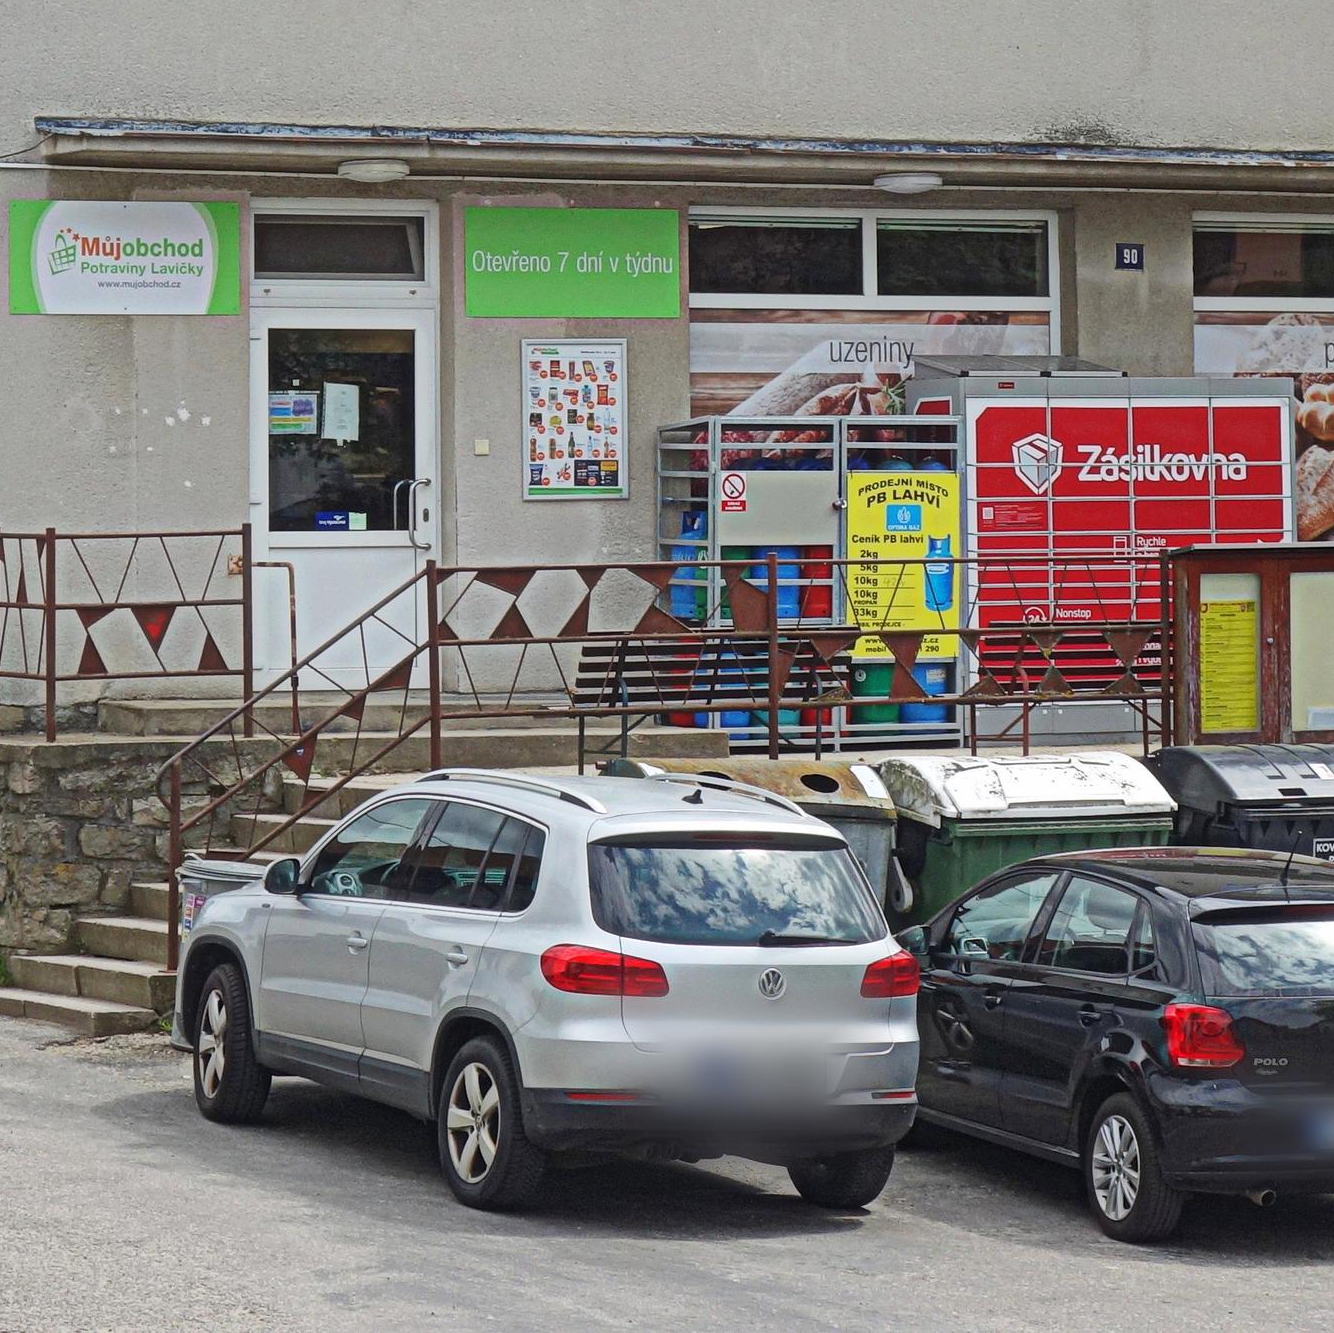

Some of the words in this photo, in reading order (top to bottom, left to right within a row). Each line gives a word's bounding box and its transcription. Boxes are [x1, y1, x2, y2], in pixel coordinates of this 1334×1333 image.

[80, 235, 204, 261] Můjobchod
[1123, 248, 1138, 265] 90
[80, 261, 146, 277] Potraviny
[150, 261, 204, 277] Lavičky
[472, 250, 551, 272] Otevřeno
[557, 251, 569, 273] 7
[576, 251, 603, 273] dní
[608, 256, 619, 273] v
[625, 251, 673, 278] týdnu
[97, 280, 182, 290] www.mujobchod.cz
[829, 335, 915, 369] uzeniny
[1076, 444, 1247, 482] Zásilkovna
[858, 477, 913, 497] PRODEJNÍ
[866, 491, 887, 508] PB
[892, 489, 941, 509] LAHVÍ
[883, 534, 897, 544] PB
[1136, 536, 1167, 547] Rychle
[860, 549, 879, 559] 2kg
[854, 576, 878, 586] 10kg
[854, 589, 878, 599] 10kg
[1055, 607, 1092, 619] Nonstop
[1253, 1057, 1289, 1066] POLO
